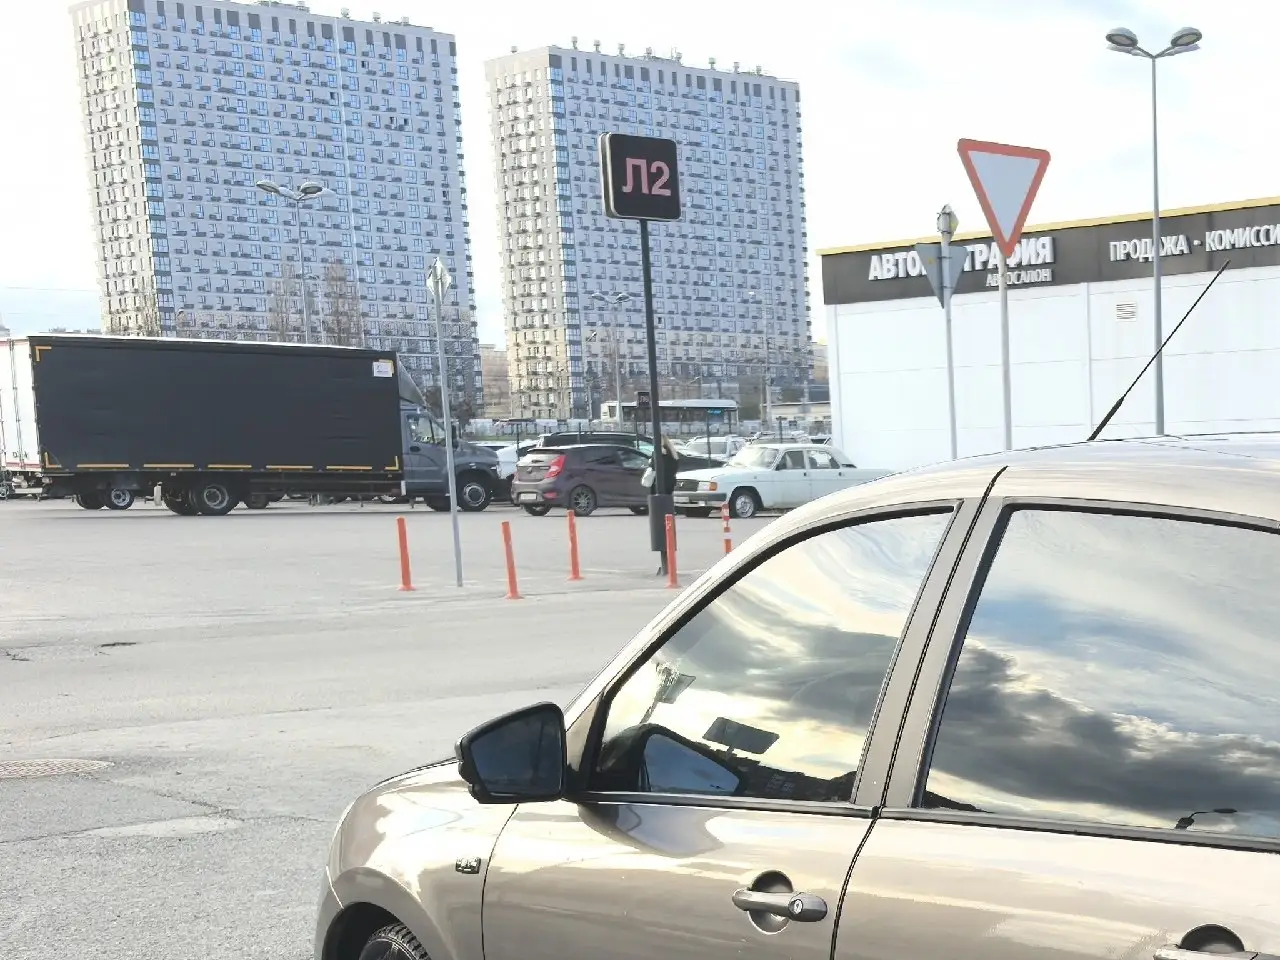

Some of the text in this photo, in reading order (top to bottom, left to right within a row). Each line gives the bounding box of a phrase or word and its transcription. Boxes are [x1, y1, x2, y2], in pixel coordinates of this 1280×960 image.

[622, 157, 672, 197] Л2
[1109, 234, 1191, 263] ПРОДЖА
[986, 268, 1053, 287] АВОСАЛОН
